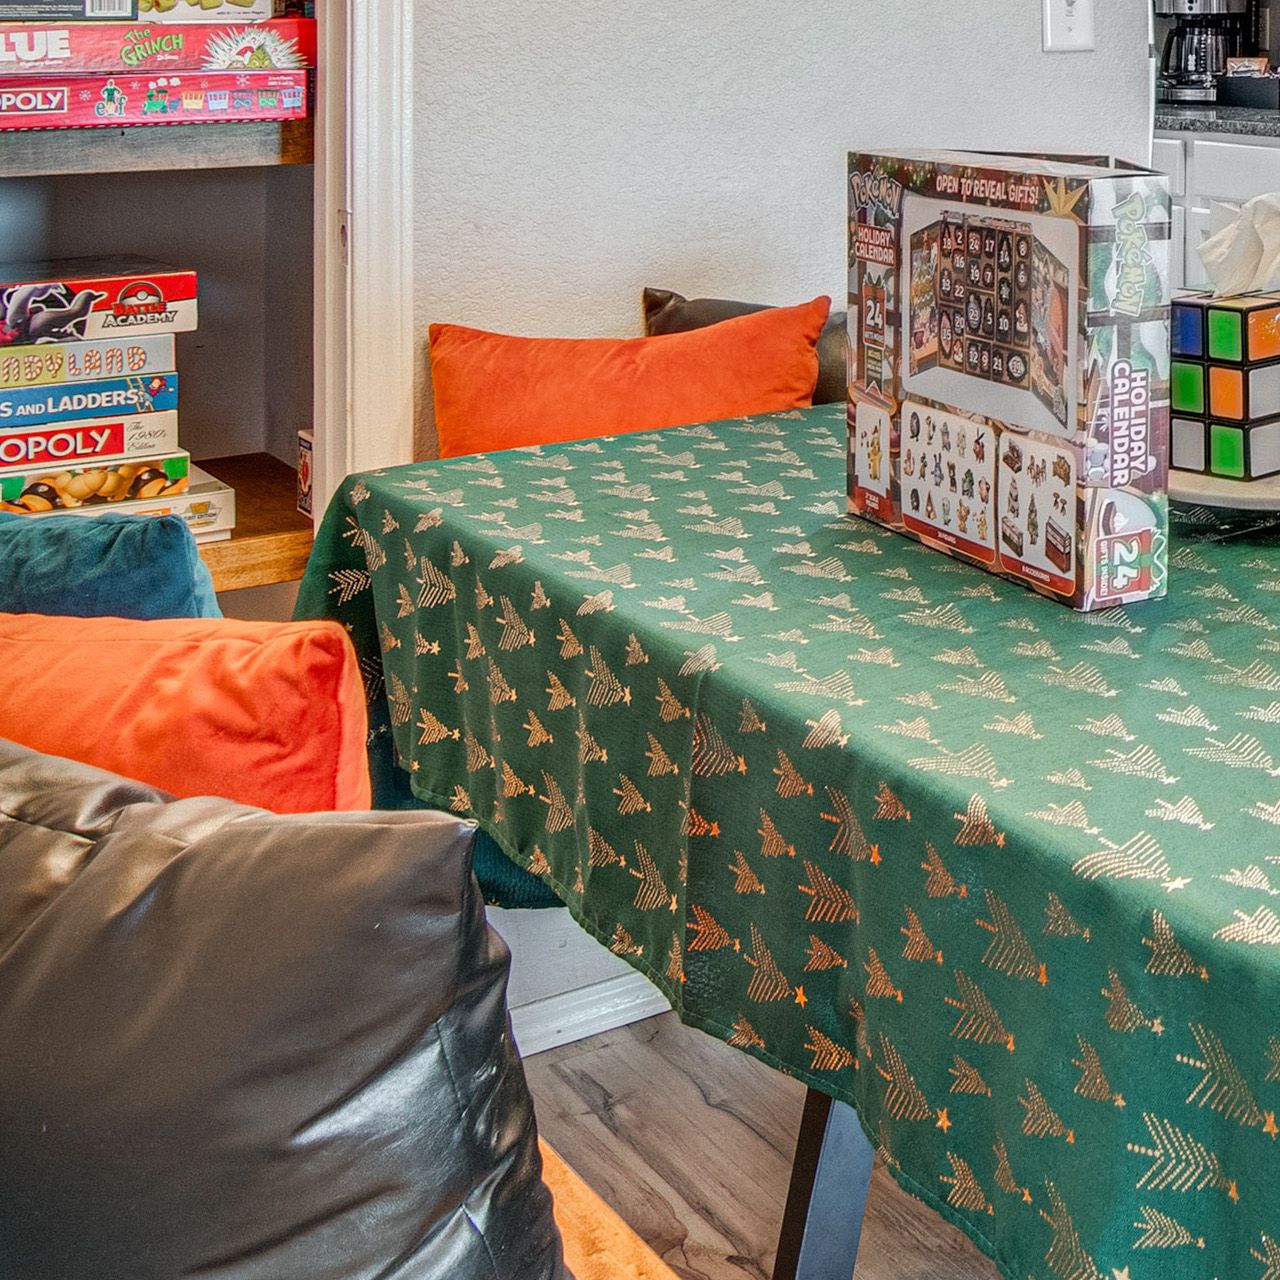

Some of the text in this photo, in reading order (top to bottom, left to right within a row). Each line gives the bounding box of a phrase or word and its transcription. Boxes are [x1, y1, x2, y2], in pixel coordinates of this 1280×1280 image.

[124, 28, 150, 43] The
[121, 34, 184, 66] GRINCH
[936, 175, 1039, 205] OPEN TO REVEAL GIFTS!
[857, 226, 891, 246] HOLIDAY
[985, 240, 994, 252] 17
[855, 242, 895, 265] CALENDAR
[102, 311, 177, 328] ACADEMY
[113, 301, 167, 316] BATTLE
[866, 300, 883, 329] 24
[16, 389, 139, 417] AND LADDERS
[1113, 362, 1131, 487] CALENDAR
[1130, 371, 1147, 471] HOLIDAY
[0, 428, 112, 463] OPOLY
[1112, 539, 1139, 590] 24
